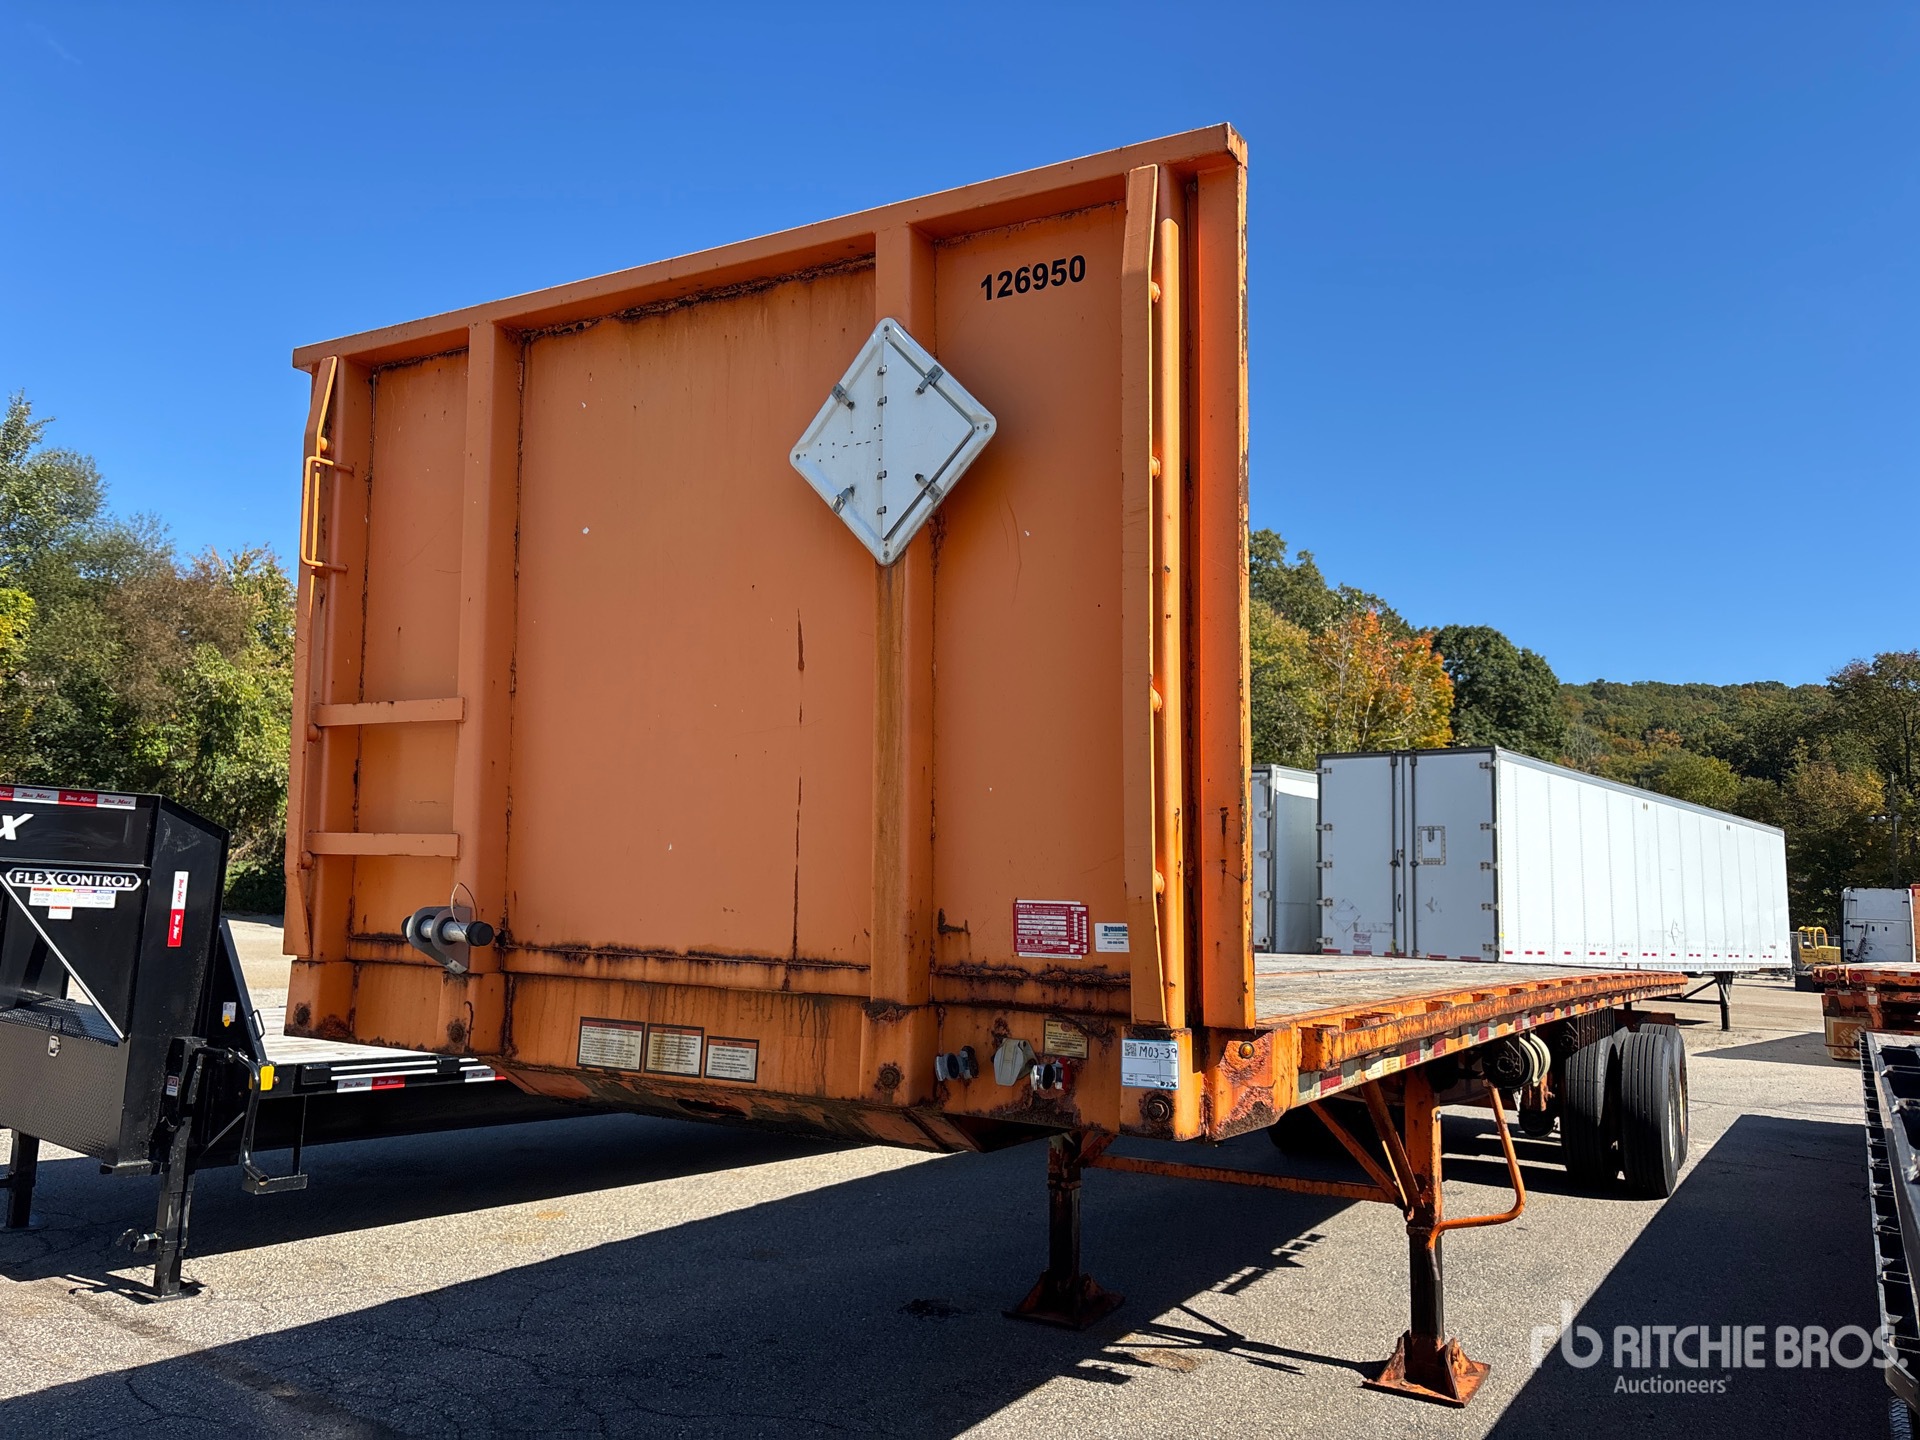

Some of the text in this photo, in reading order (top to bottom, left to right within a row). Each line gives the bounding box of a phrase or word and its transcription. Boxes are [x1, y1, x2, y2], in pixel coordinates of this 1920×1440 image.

[981, 255, 1086, 301] 126950
[14, 870, 133, 888] FLEXCONTROL
[1138, 1045, 1178, 1059] M03-39
